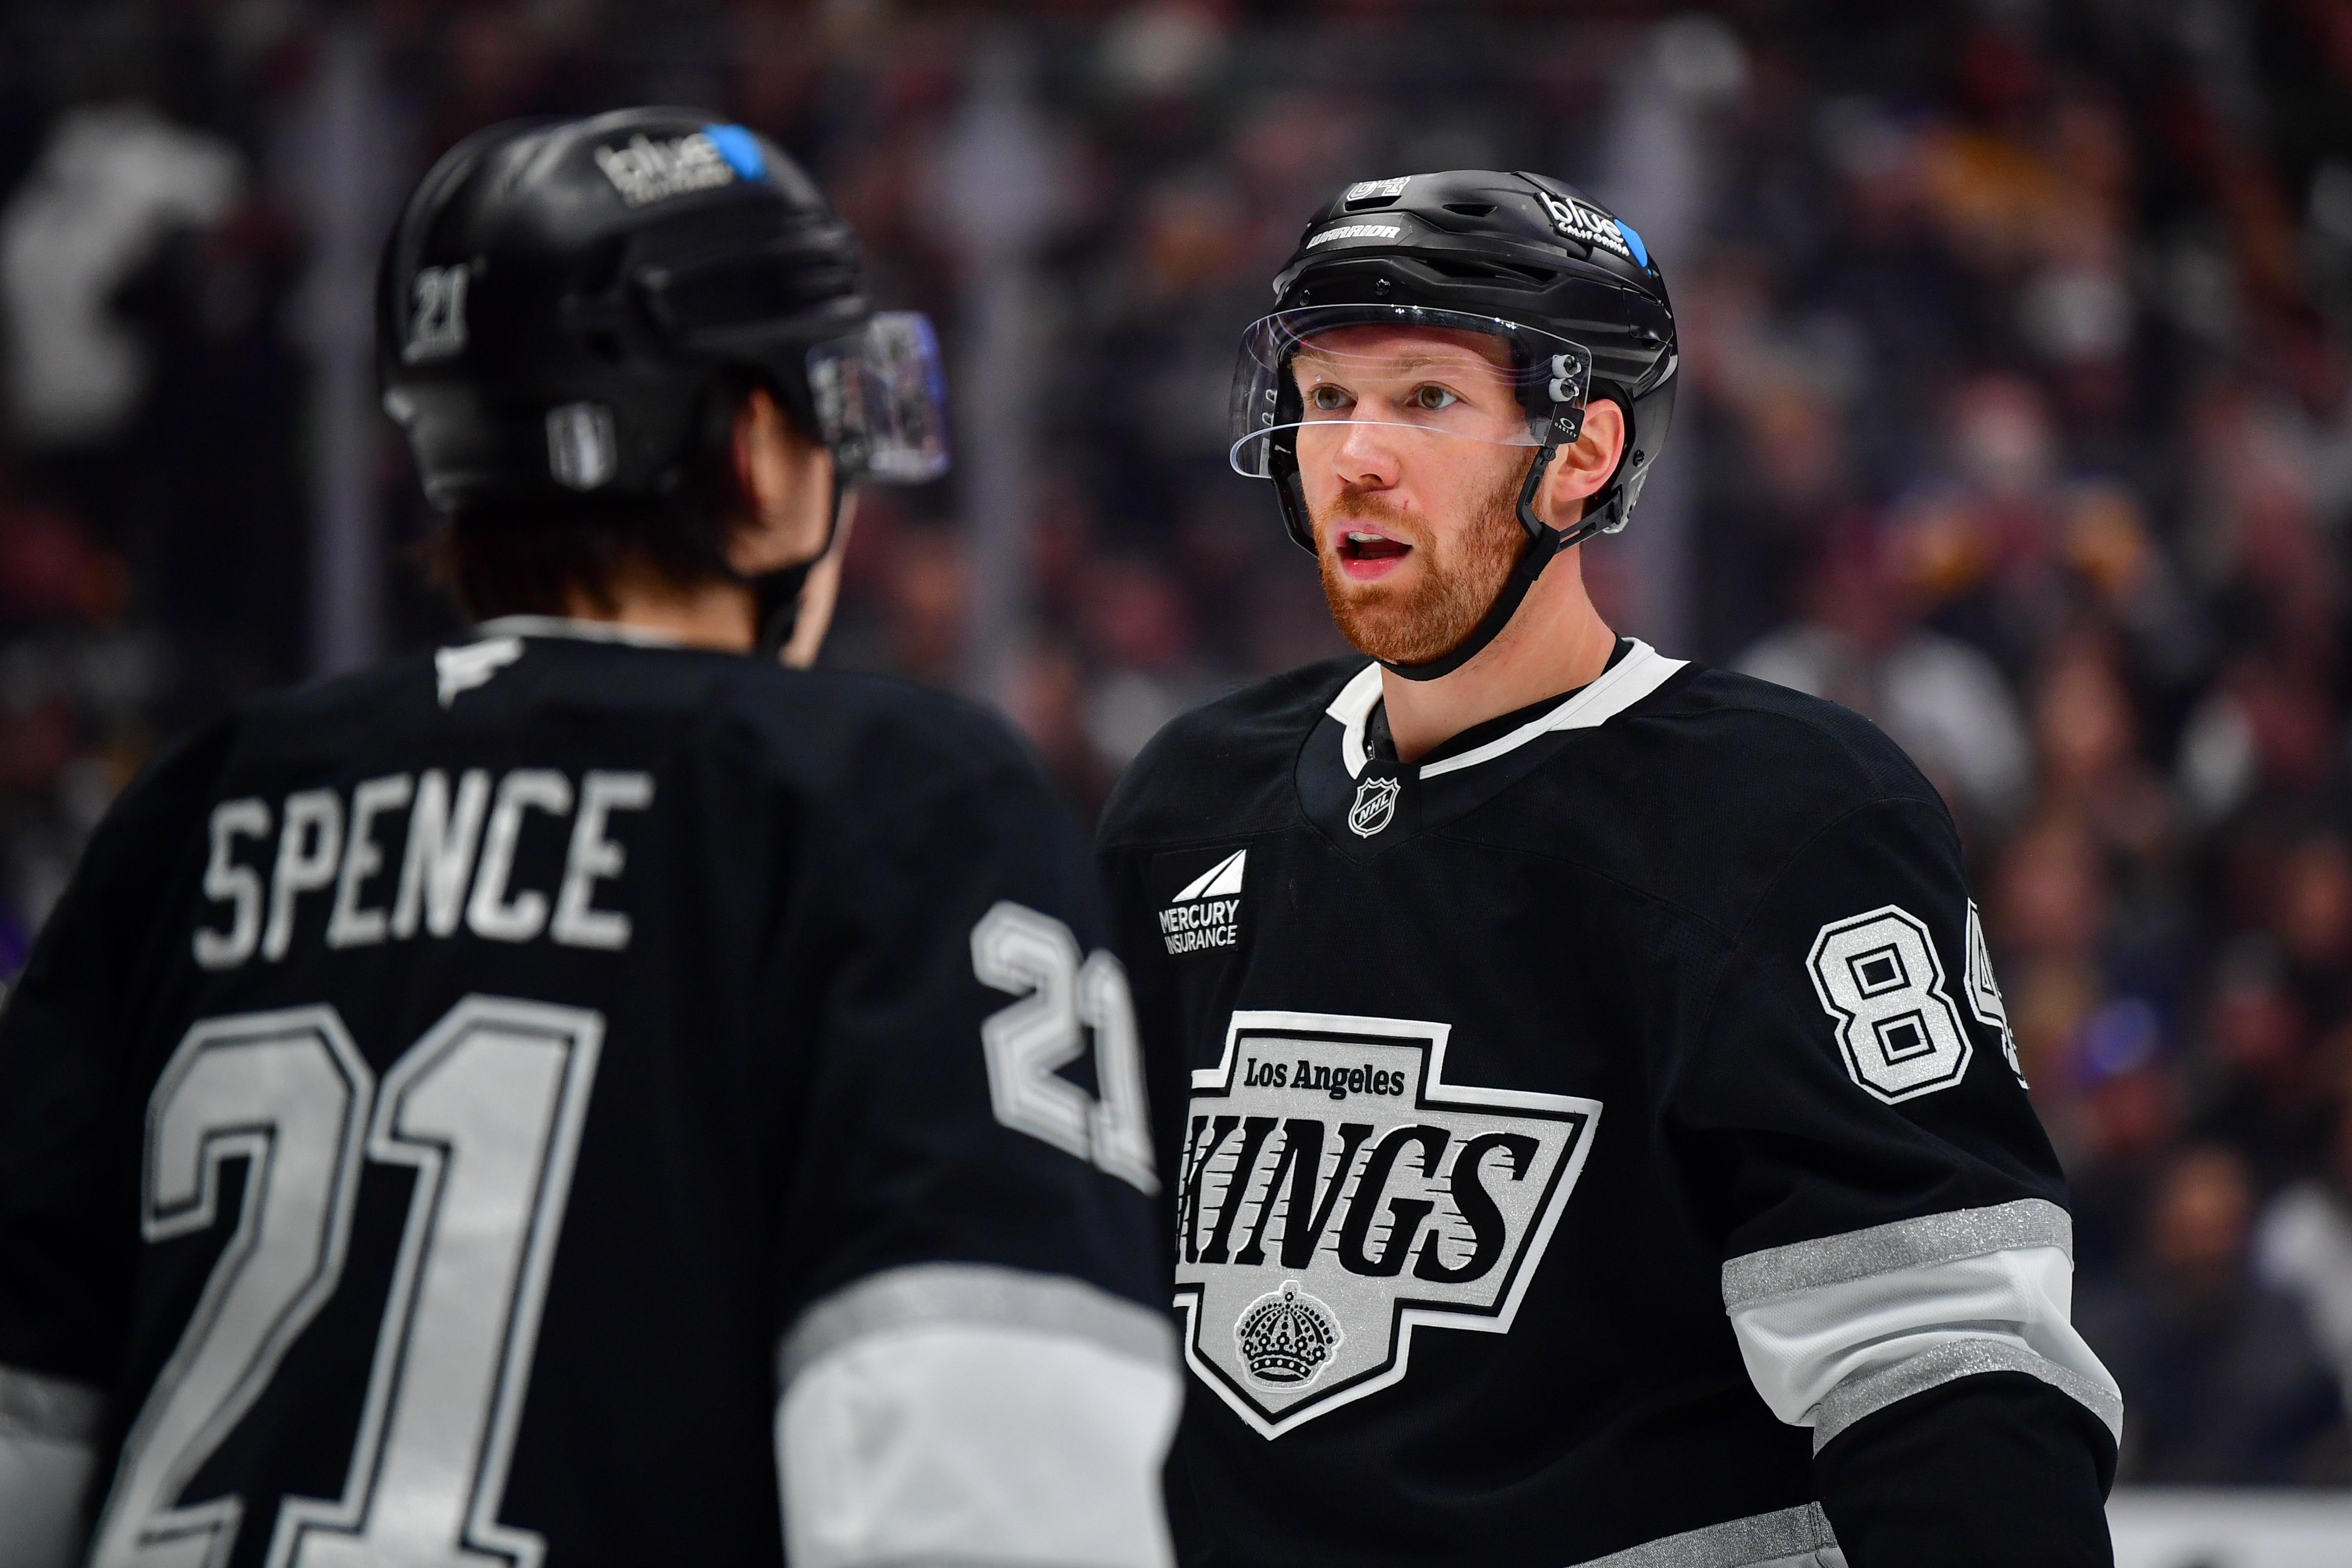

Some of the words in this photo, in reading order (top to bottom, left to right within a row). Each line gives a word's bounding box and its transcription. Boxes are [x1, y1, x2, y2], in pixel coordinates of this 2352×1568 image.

[1306, 224, 1401, 250] WARRIOR
[1540, 191, 1624, 243] blue
[1558, 222, 1630, 257] CALIFORNIA
[399, 263, 471, 365] 21
[1554, 422, 1577, 439] OAKLEY
[1358, 793, 1389, 824] NHL
[192, 768, 657, 972] SPENCE
[1158, 899, 1240, 934] MERCURY
[1164, 925, 1238, 955] INSURANCE
[969, 899, 1163, 1199] 21
[1243, 1057, 1287, 1088] Los
[1289, 1060, 1406, 1100] Angeles
[1175, 1115, 1541, 1283] KINGS
[88, 993, 607, 1568] 21
